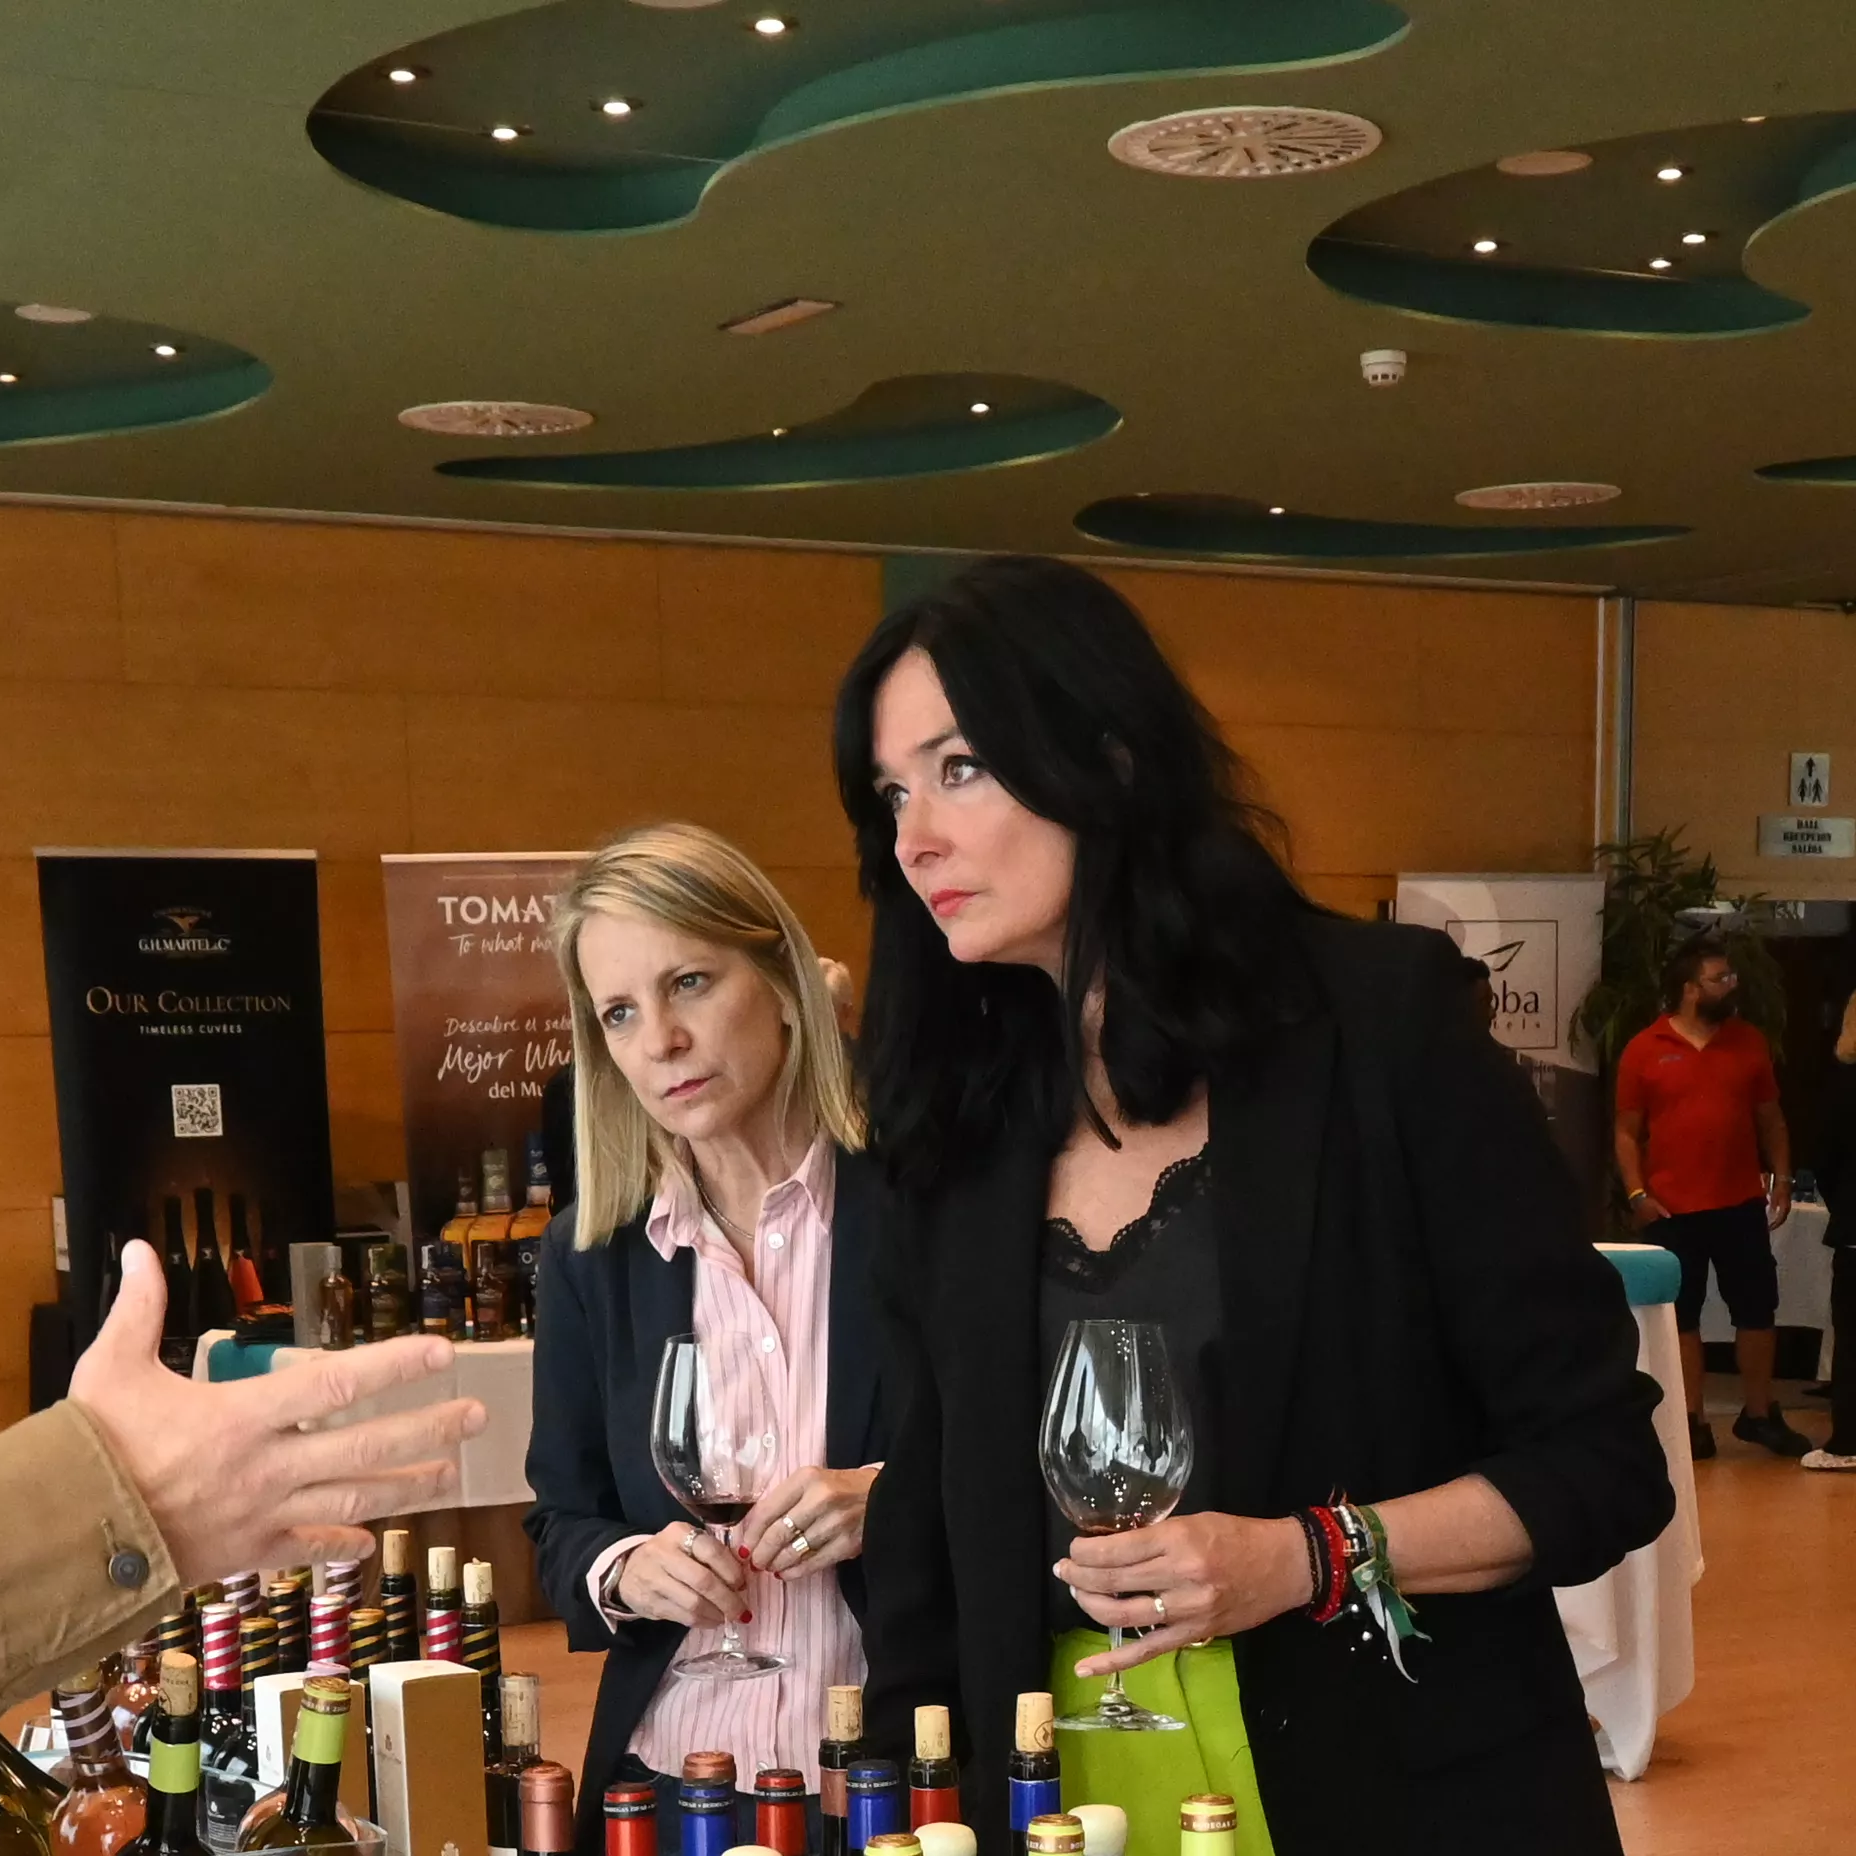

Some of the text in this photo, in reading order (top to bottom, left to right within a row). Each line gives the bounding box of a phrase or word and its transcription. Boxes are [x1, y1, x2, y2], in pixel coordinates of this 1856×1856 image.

[482, 932, 524, 953] what
[140, 1025, 193, 1035] TIMELESS
[437, 1043, 514, 1084] Mejor
[488, 1081, 515, 1099] del
